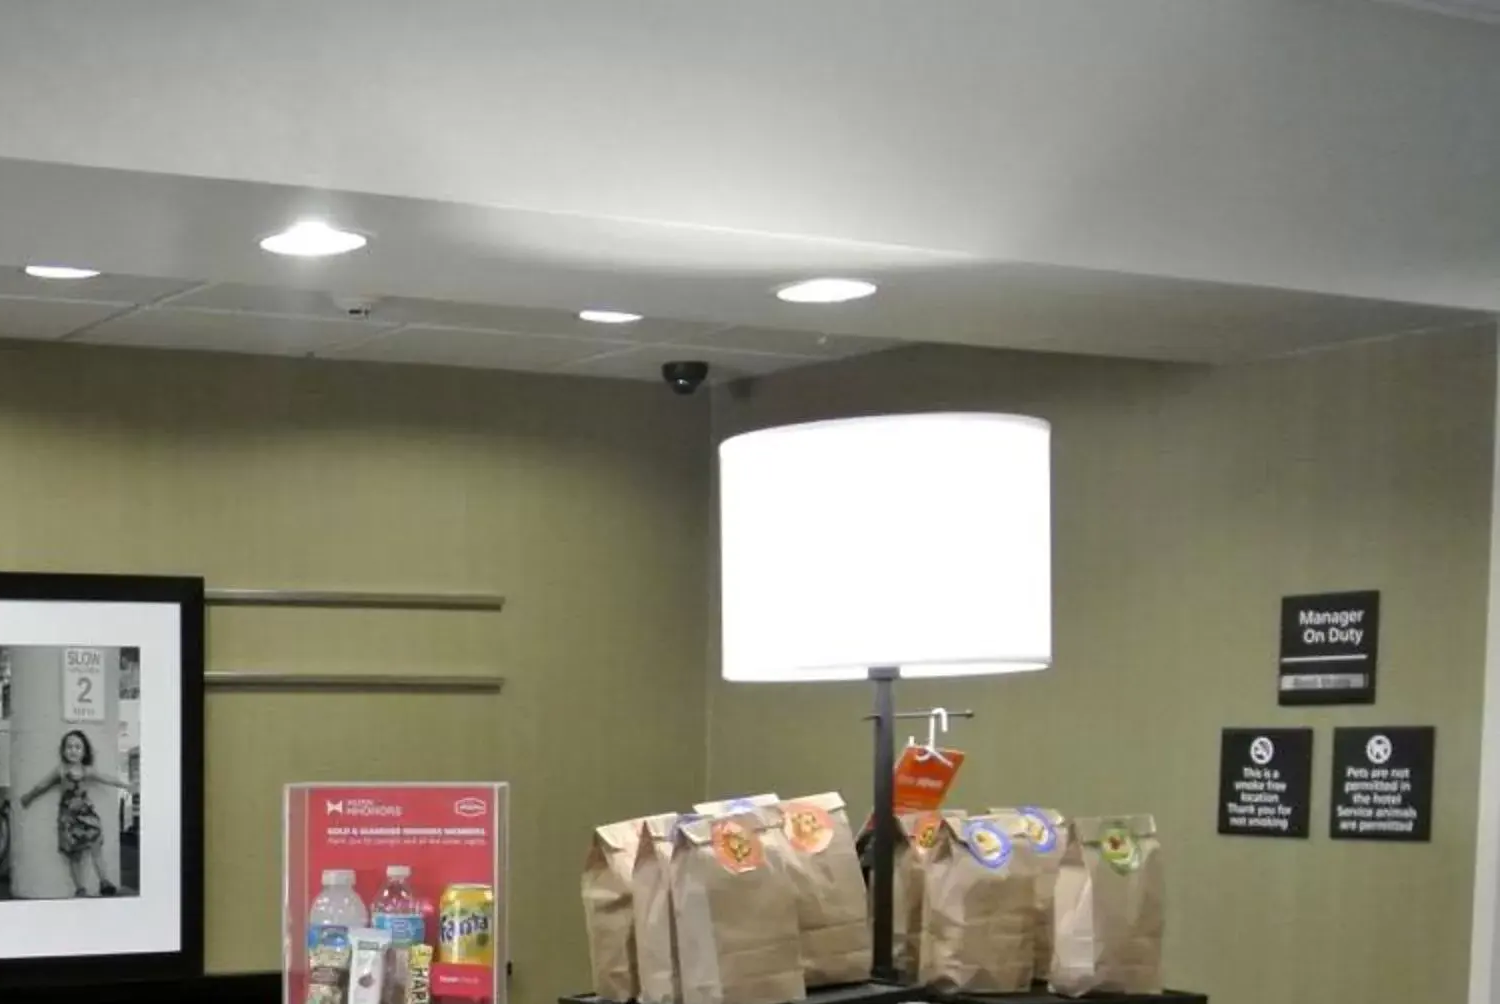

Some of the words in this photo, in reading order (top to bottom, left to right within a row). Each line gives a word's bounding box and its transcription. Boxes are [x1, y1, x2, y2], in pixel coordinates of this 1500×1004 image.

[1298, 609, 1365, 628] Manager
[1303, 627, 1325, 644] On
[1327, 626, 1364, 646] Duty
[76, 677, 93, 703] 2
